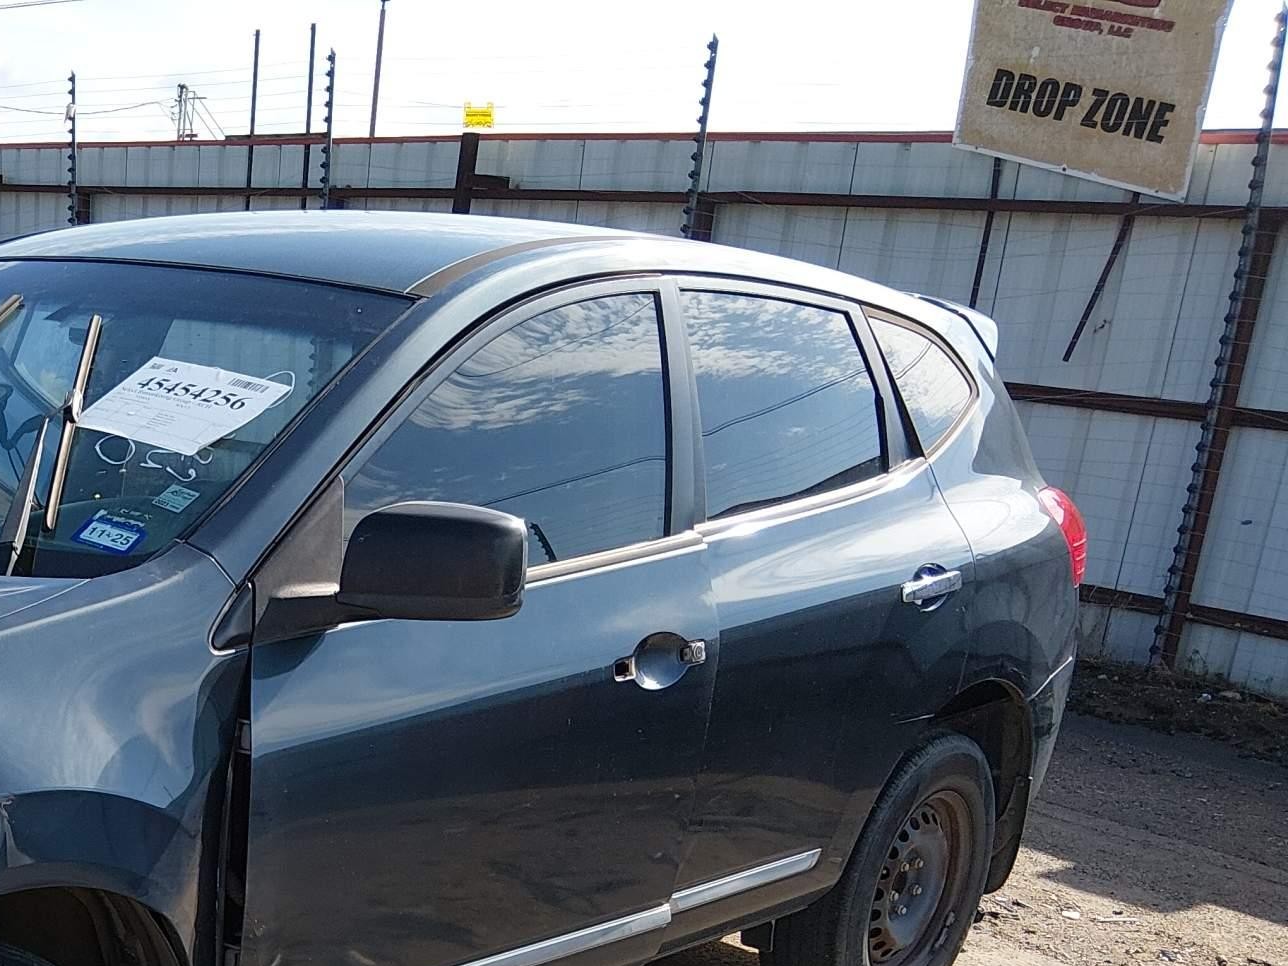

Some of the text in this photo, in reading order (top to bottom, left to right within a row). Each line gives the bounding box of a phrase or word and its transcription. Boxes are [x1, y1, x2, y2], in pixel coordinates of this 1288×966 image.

[986, 68, 1176, 144] DROP ZONE
[137, 376, 253, 411] 45454256
